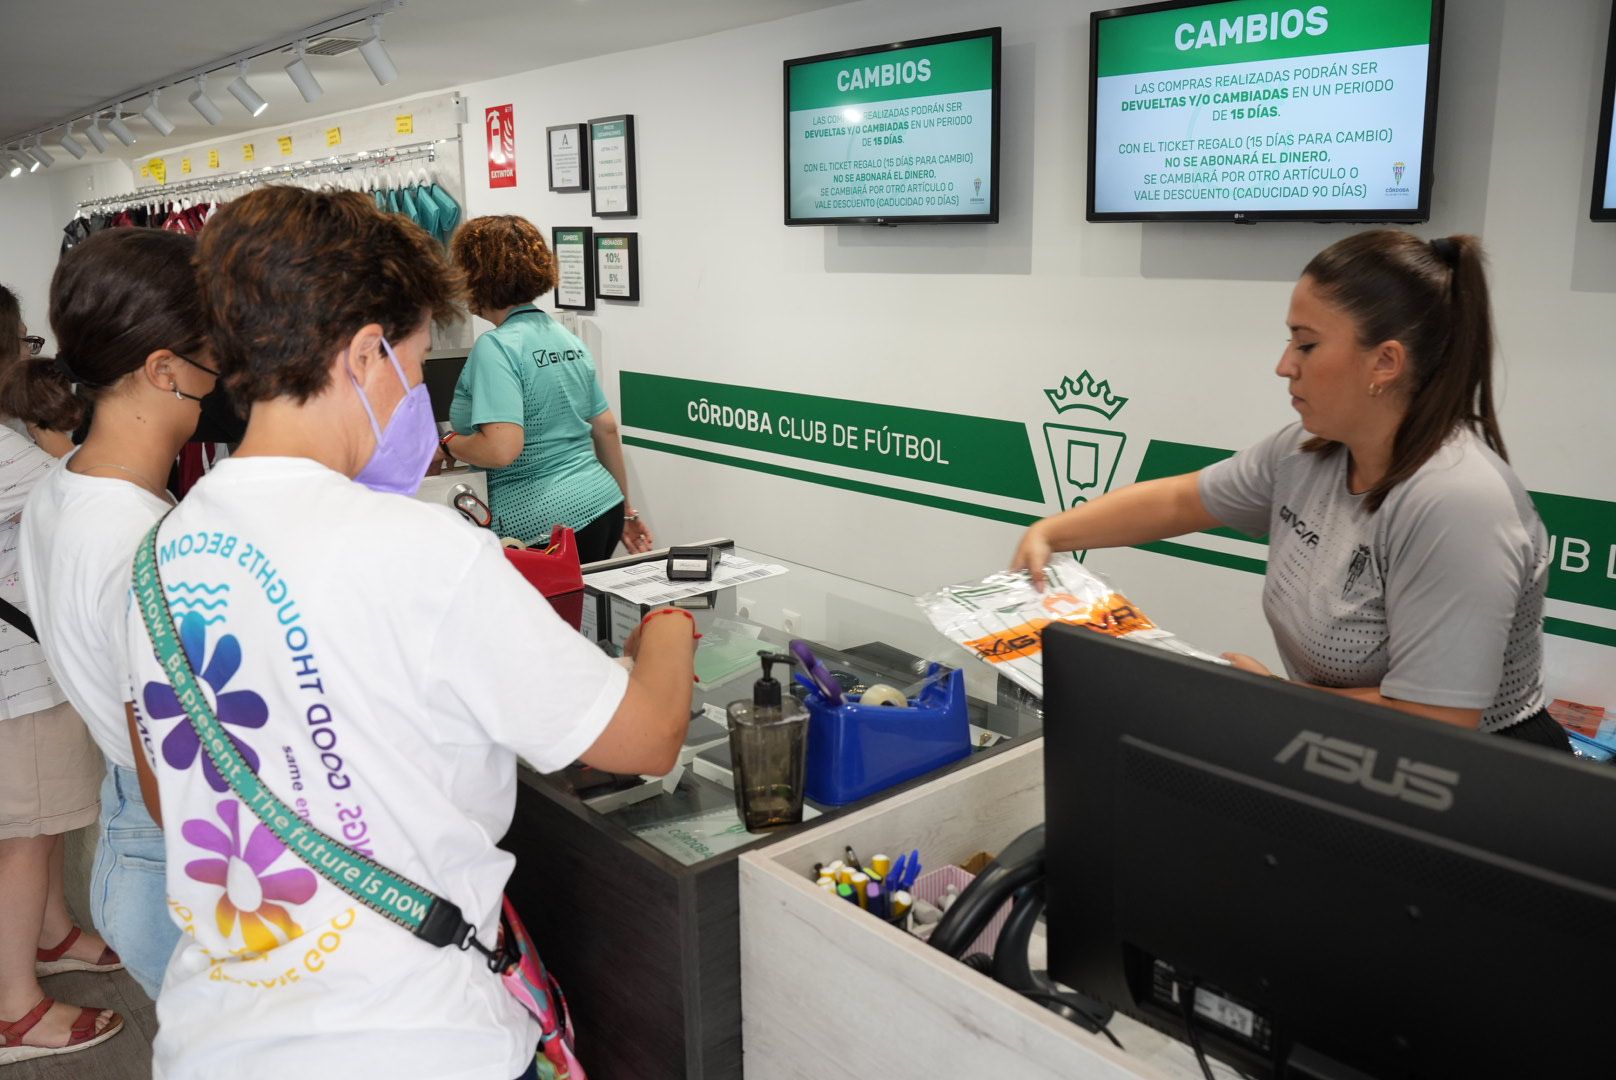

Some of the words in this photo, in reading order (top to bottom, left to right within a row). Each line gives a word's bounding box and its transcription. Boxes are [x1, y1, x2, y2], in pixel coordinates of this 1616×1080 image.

[1174, 5, 1329, 51] CAMBIOS
[837, 58, 932, 92] CAMBIOS
[1134, 82, 1155, 95] LAS
[1157, 77, 1212, 93] COMPRAS
[1215, 69, 1290, 88] REALIZADAS
[1293, 62, 1348, 81] PODRÁN
[1351, 61, 1378, 76] SER
[1121, 96, 1187, 112] DEVUELTAS
[1188, 93, 1211, 107] Y/O
[1213, 87, 1289, 104] CAMBIADAS
[1292, 85, 1309, 99] EN
[1312, 84, 1331, 97] UN
[1335, 78, 1394, 95] PERIODO
[812, 115, 826, 126] LAS
[911, 102, 945, 116] PODRÁN
[945, 101, 963, 113] SER
[1212, 109, 1228, 122] DE
[1230, 108, 1245, 120] 15
[1247, 105, 1281, 119] DÍAS.
[804, 127, 846, 139] DEVUELTAS
[847, 126, 861, 136] Y/O
[862, 120, 910, 134] CAMBIADAS
[910, 119, 922, 130] EN
[923, 118, 935, 129] UN
[936, 114, 973, 127] PERIODO
[862, 137, 872, 147] DE
[873, 136, 883, 146] 15
[1118, 143, 1141, 155] CON
[1143, 142, 1156, 153] EL
[1157, 139, 1196, 152] TICKET
[1197, 136, 1243, 150] REGALO
[1246, 135, 1263, 150] (15
[1266, 132, 1295, 147] DÍAS
[1298, 132, 1333, 145] PARA
[1335, 127, 1393, 144] CAMBIO)
[803, 163, 818, 173] CON
[819, 162, 828, 172] EL
[828, 160, 852, 171] TICKET
[853, 158, 883, 169] REGALO
[883, 157, 895, 169] (15
[895, 155, 914, 167] DÍAS
[915, 155, 938, 166] PARA
[938, 152, 974, 165] CAMBIO)
[1164, 156, 1181, 168] NO
[1183, 156, 1198, 167] SE
[1199, 150, 1259, 167] ABONARÁ
[1261, 152, 1277, 164] EL
[491, 169, 514, 179] EXTINTOR
[833, 174, 844, 183] NO
[844, 173, 855, 183] SE
[855, 169, 893, 182] ABONARÁ
[893, 170, 904, 180] EL
[1143, 173, 1157, 185] SE
[1159, 169, 1218, 185] CAMBIARÁ
[1221, 170, 1245, 183] POR
[1248, 169, 1280, 182] OTRO
[1282, 165, 1346, 181] ARTÍCULO
[1349, 166, 1359, 179] O
[820, 187, 829, 197] SE
[830, 183, 868, 197] CAMBIARÁ
[868, 184, 884, 195] POR
[885, 183, 906, 194] OTRO
[906, 181, 946, 193] ARTÍCULO
[947, 181, 954, 192] O
[1133, 189, 1161, 201] VALE
[1163, 187, 1230, 201] DESCUENTO
[1232, 186, 1309, 201] (CADUCIDAD
[1312, 185, 1328, 198] 90
[1332, 182, 1367, 199] DÍAS)
[814, 199, 832, 209] VALE
[832, 198, 876, 209] DESCUENTO
[876, 196, 924, 209] (CADUCIDAD
[925, 196, 936, 206] 90
[937, 193, 960, 207] DÍAS)
[605, 252, 621, 263] 10%
[608, 273, 619, 282] 5%
[778, 415, 827, 444] CLUB
[833, 423, 859, 450] DE
[864, 425, 950, 465] FÚTBOL
[282, 745, 304, 791] same
[1273, 729, 1460, 812] ASUS
[167, 653, 186, 686] Be
[251, 786, 290, 830] The
[289, 826, 361, 883] future
[359, 872, 383, 895] is
[381, 887, 428, 922] now
